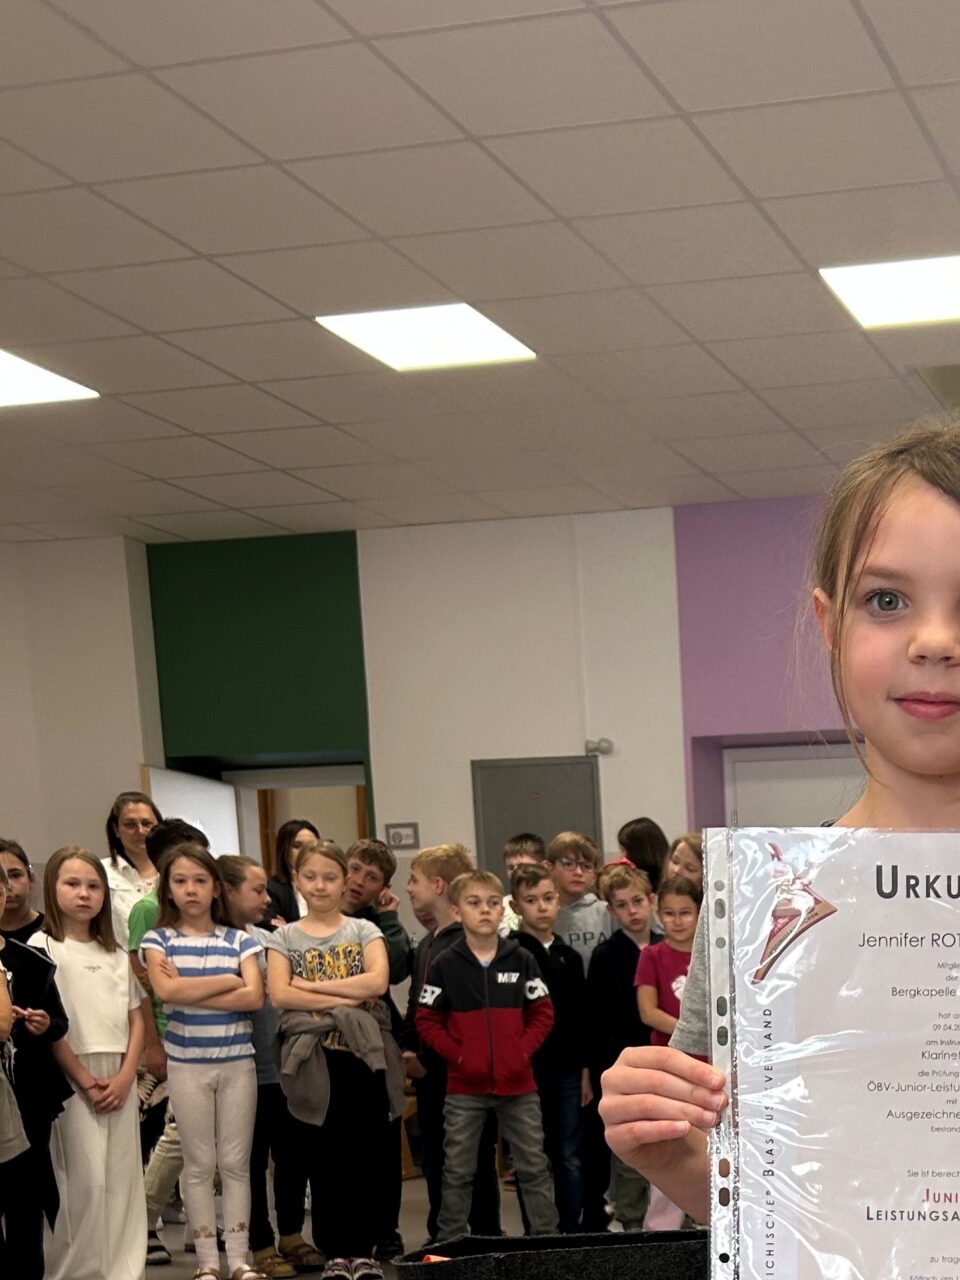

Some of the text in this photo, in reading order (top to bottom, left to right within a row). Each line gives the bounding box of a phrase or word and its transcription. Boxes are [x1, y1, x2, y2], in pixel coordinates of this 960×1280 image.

[858, 932, 926, 948] Jennifer
[891, 986, 957, 999] Bergkapelle
[931, 1069, 960, 1078] Prüfung
[906, 1169, 919, 1178] Sie
[921, 1169, 930, 1178] ist
